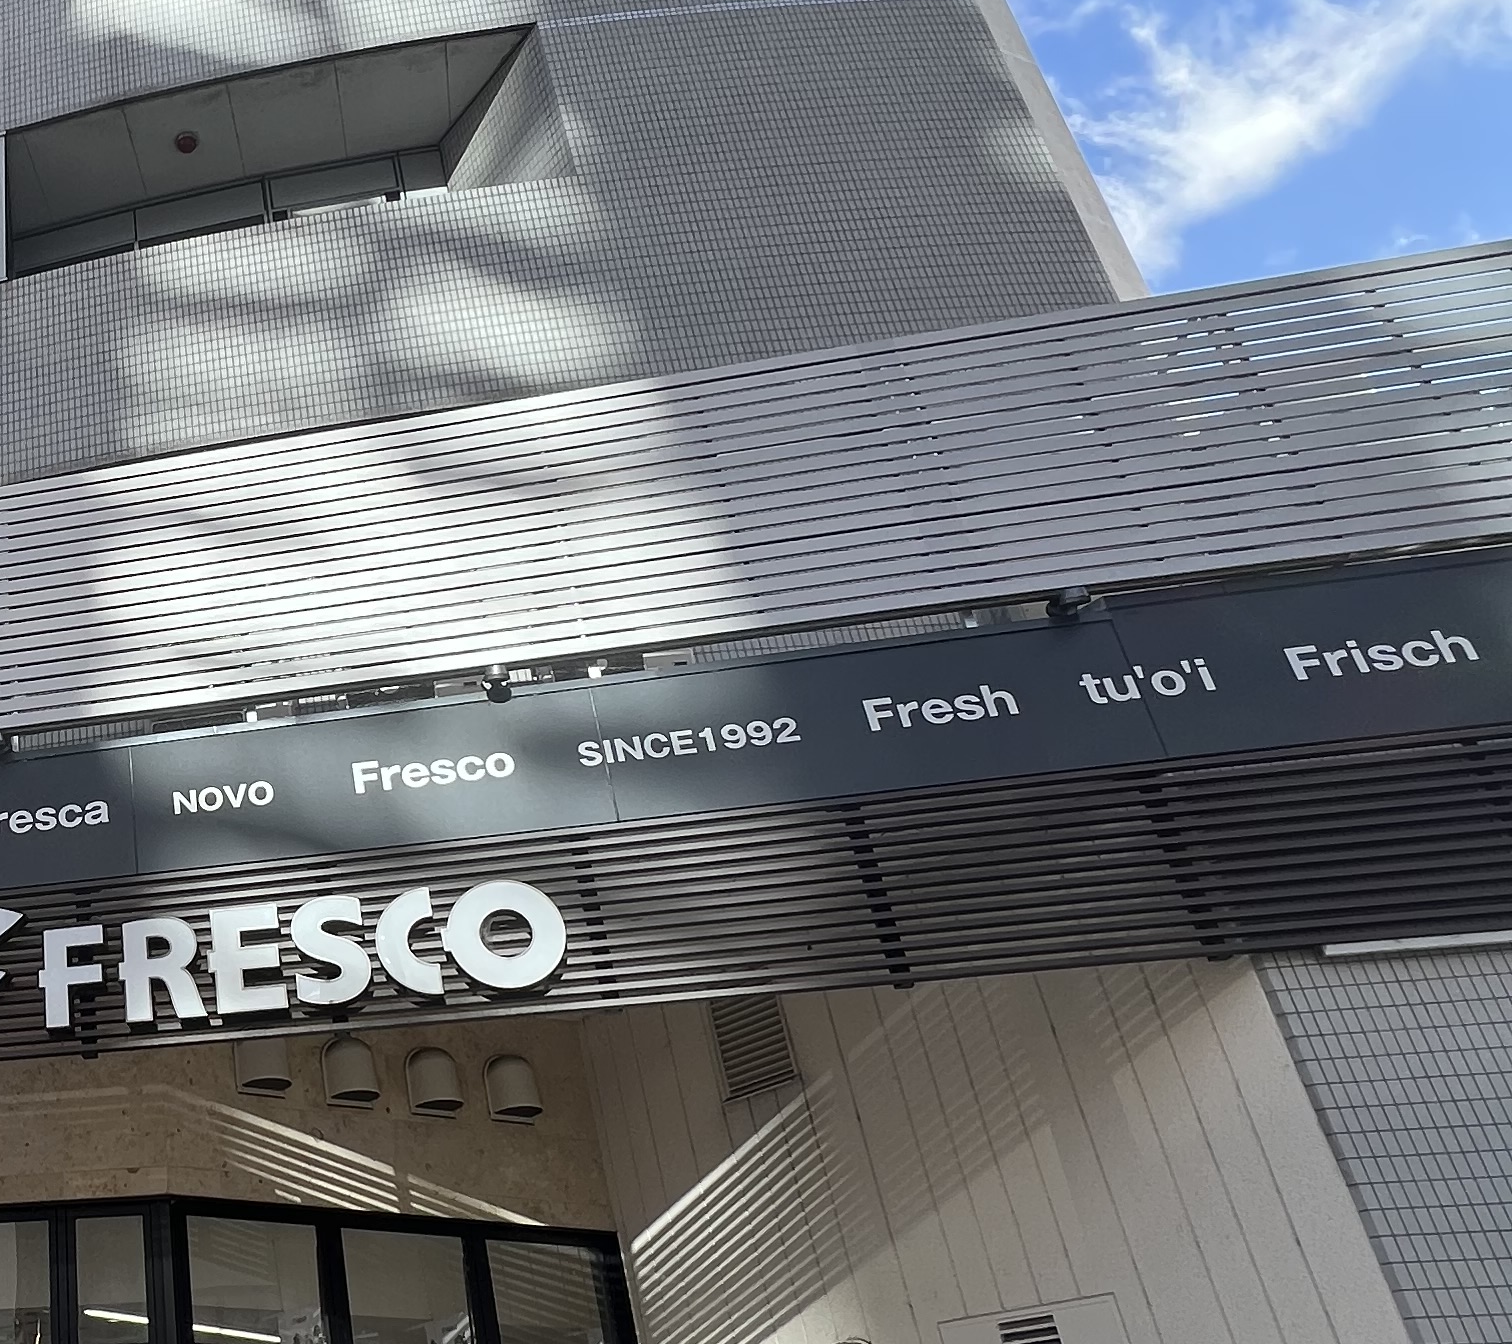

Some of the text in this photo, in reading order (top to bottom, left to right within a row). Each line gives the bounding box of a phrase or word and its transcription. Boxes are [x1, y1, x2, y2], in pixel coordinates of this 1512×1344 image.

[172, 780, 275, 815] NOVO
[351, 752, 516, 794] Fresco
[577, 717, 801, 767] SINCE1992
[862, 684, 1020, 732] Fresh
[1283, 630, 1480, 681] Frisch
[39, 878, 568, 1030] FRESCO
